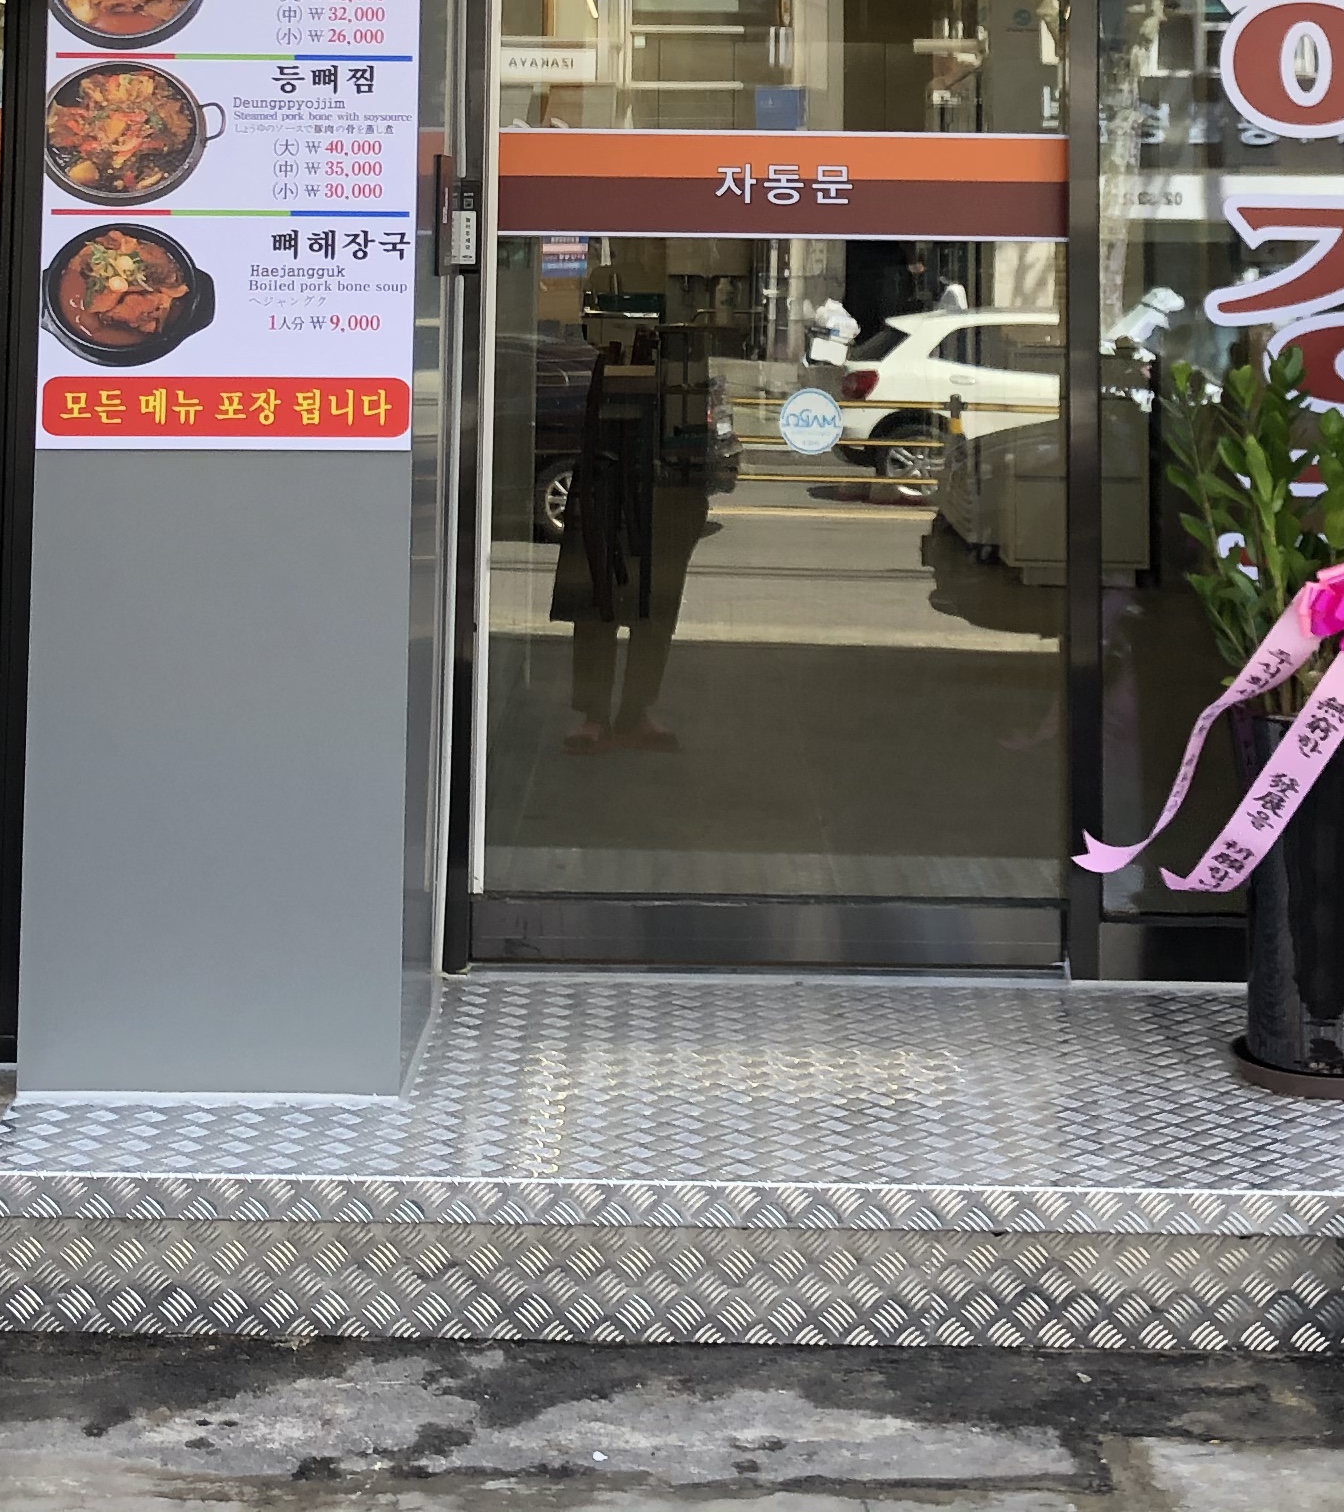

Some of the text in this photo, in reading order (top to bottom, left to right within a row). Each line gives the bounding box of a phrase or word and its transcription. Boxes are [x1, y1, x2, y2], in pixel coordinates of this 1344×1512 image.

[277, 6, 303, 23] (中)
[276, 27, 303, 45] (小)
[272, 65, 375, 94] 등뼈찜
[233, 97, 346, 110] Deungppyojjim
[234, 111, 277, 121] Steamed
[281, 112, 304, 122] pork
[309, 112, 333, 122] bone
[337, 113, 360, 122] with
[274, 138, 299, 156] (大)
[273, 160, 299, 178] (中)
[272, 182, 299, 200] (小)
[715, 163, 854, 206] 자동문
[271, 229, 411, 260] 뼈해장국
[250, 265, 346, 278] Haejangguk
[249, 280, 407, 293] Boiled pork bone soup
[60, 387, 393, 426] 모든 메뉴 포장 됩니다
